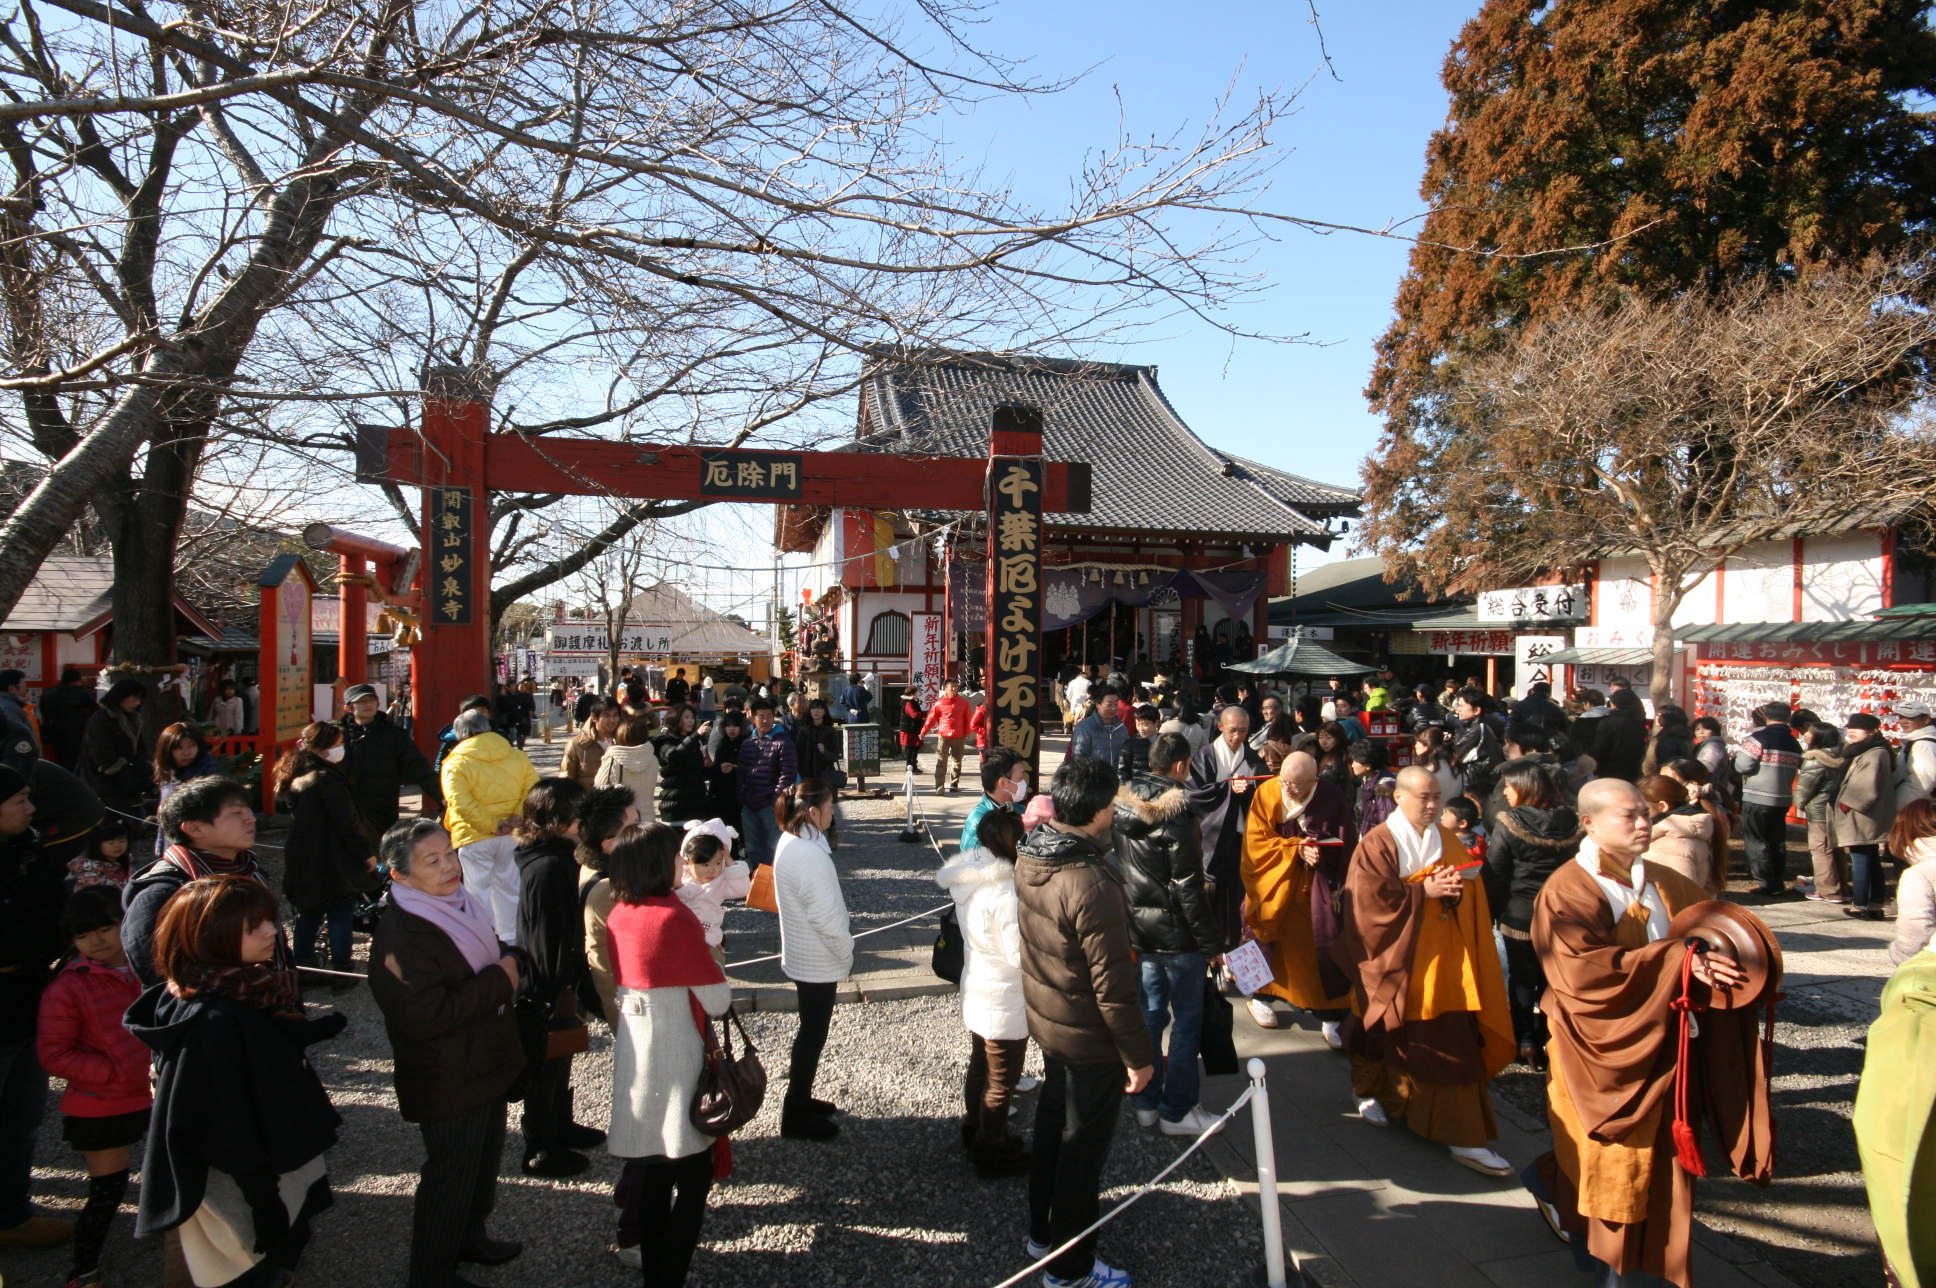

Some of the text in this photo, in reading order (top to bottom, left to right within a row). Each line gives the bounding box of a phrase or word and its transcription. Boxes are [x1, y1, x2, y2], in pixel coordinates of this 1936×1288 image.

[704, 462, 797, 491] 厄除門
[1487, 591, 1576, 616] 総合受付
[996, 466, 1038, 793] 千葉厄よけ不動
[1281, 627, 1318, 638] 護木
[1431, 631, 1555, 652] 新年祈願
[923, 616, 940, 710] 新年祈願大祭
